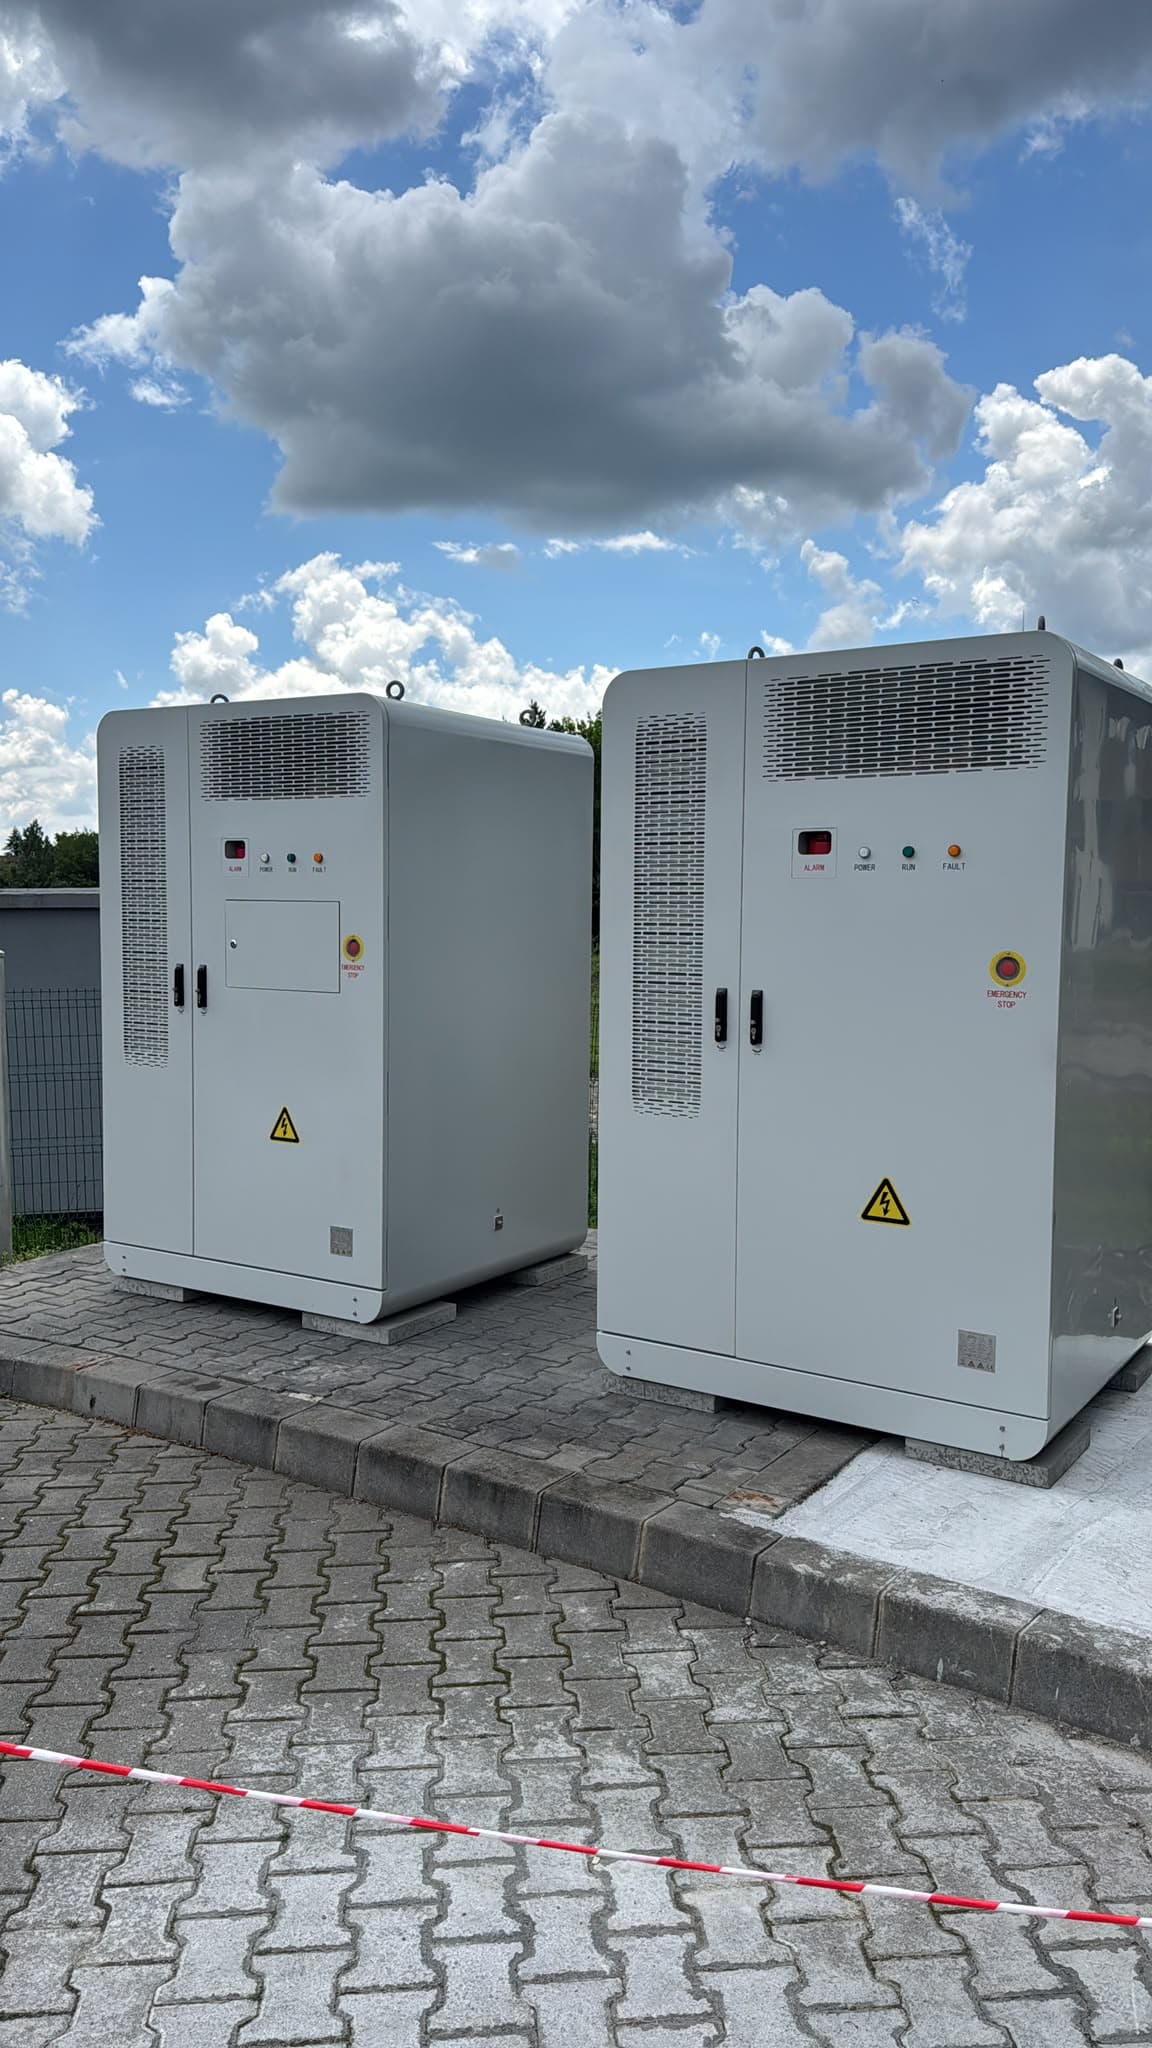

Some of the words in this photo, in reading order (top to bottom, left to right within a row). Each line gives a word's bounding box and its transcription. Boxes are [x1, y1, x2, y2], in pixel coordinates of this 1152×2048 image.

[901, 863, 916, 871] RUN
[942, 862, 966, 871] FAULT
[986, 990, 1028, 999] EMERGENCY
[997, 1000, 1016, 1008] STOP
